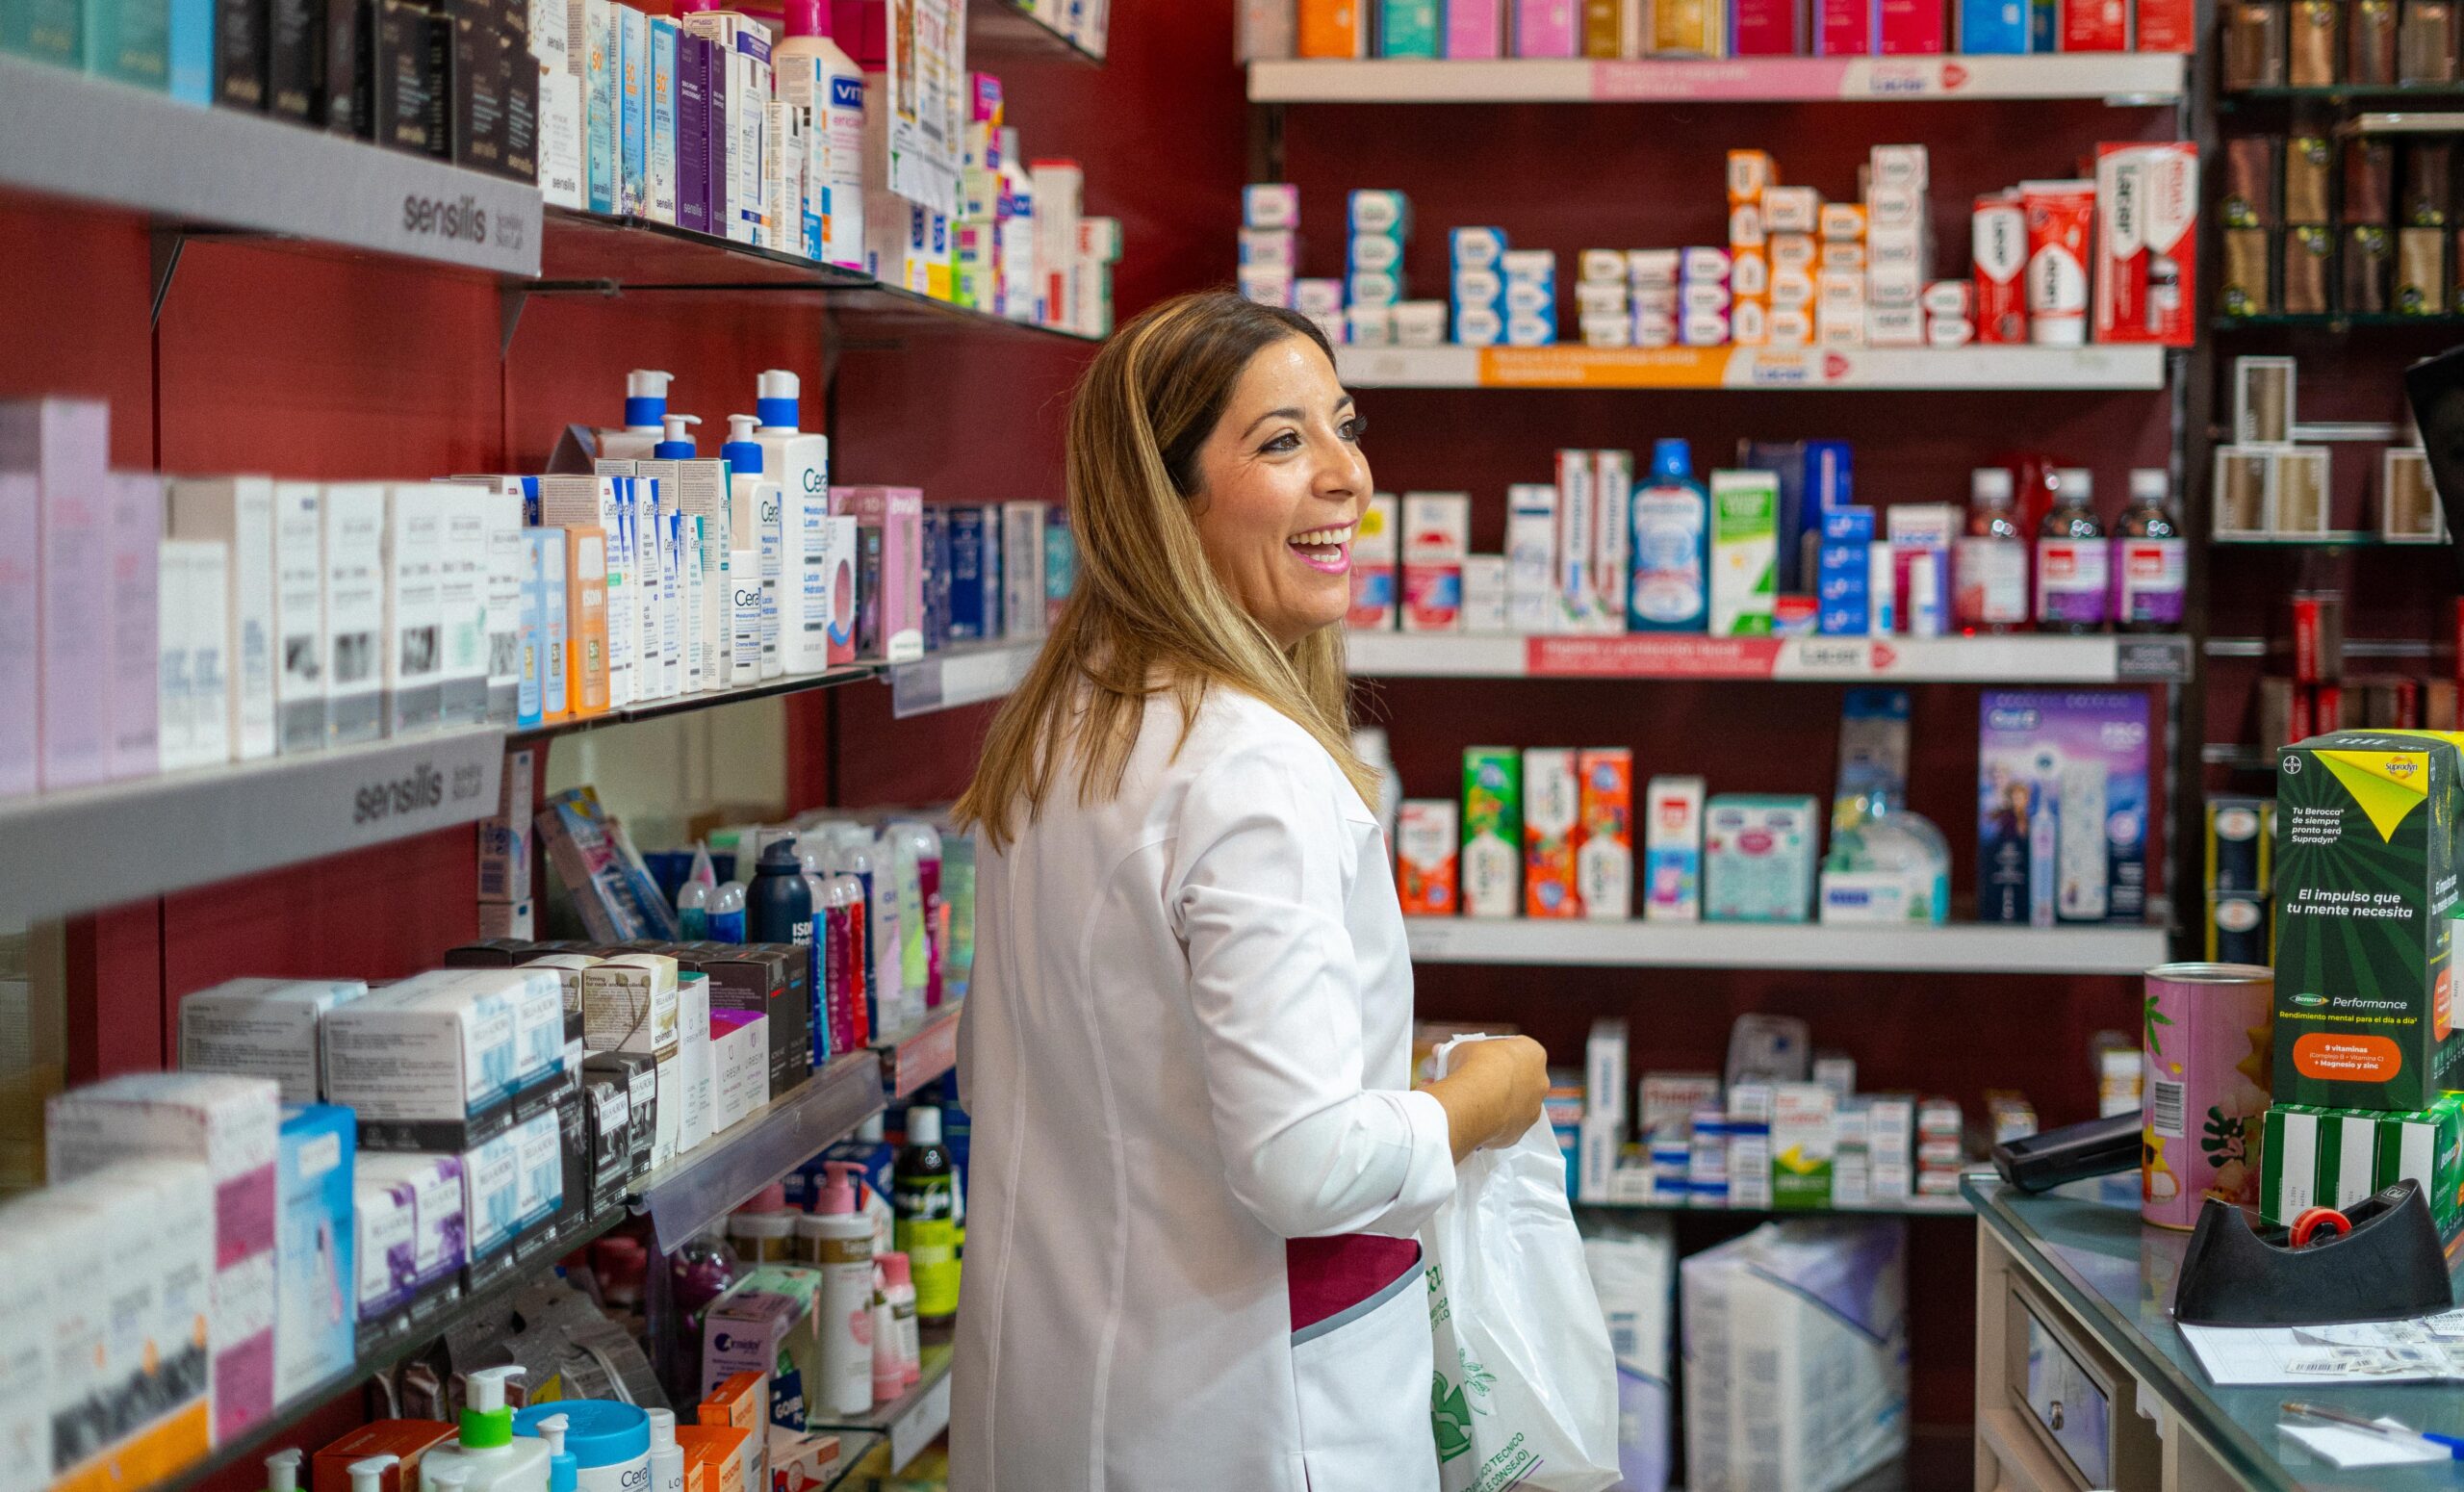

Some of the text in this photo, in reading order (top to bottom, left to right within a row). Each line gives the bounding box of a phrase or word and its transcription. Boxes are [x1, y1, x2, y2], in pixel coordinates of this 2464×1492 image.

[547, 36, 565, 52] sensilis
[552, 177, 576, 193] sensilis
[403, 193, 486, 244] sensilis
[353, 759, 443, 825] sensilis
[2304, 817, 2340, 826] siempre
[2292, 826, 2342, 836] pronto será
[2298, 888, 2401, 906] El impulso que
[2287, 903, 2413, 918] tu mente necesita
[2333, 997, 2407, 1010] Performance
[2279, 1011, 2326, 1021] Rendimiento
[2327, 1014, 2354, 1022] mental
[2355, 1016, 2373, 1024] para
[2374, 1015, 2381, 1023] el
[2321, 1060, 2356, 1069] Magnesio
[1489, 1432, 1525, 1467] TECNICO
[1491, 1449, 1530, 1486] CONSEJO)
